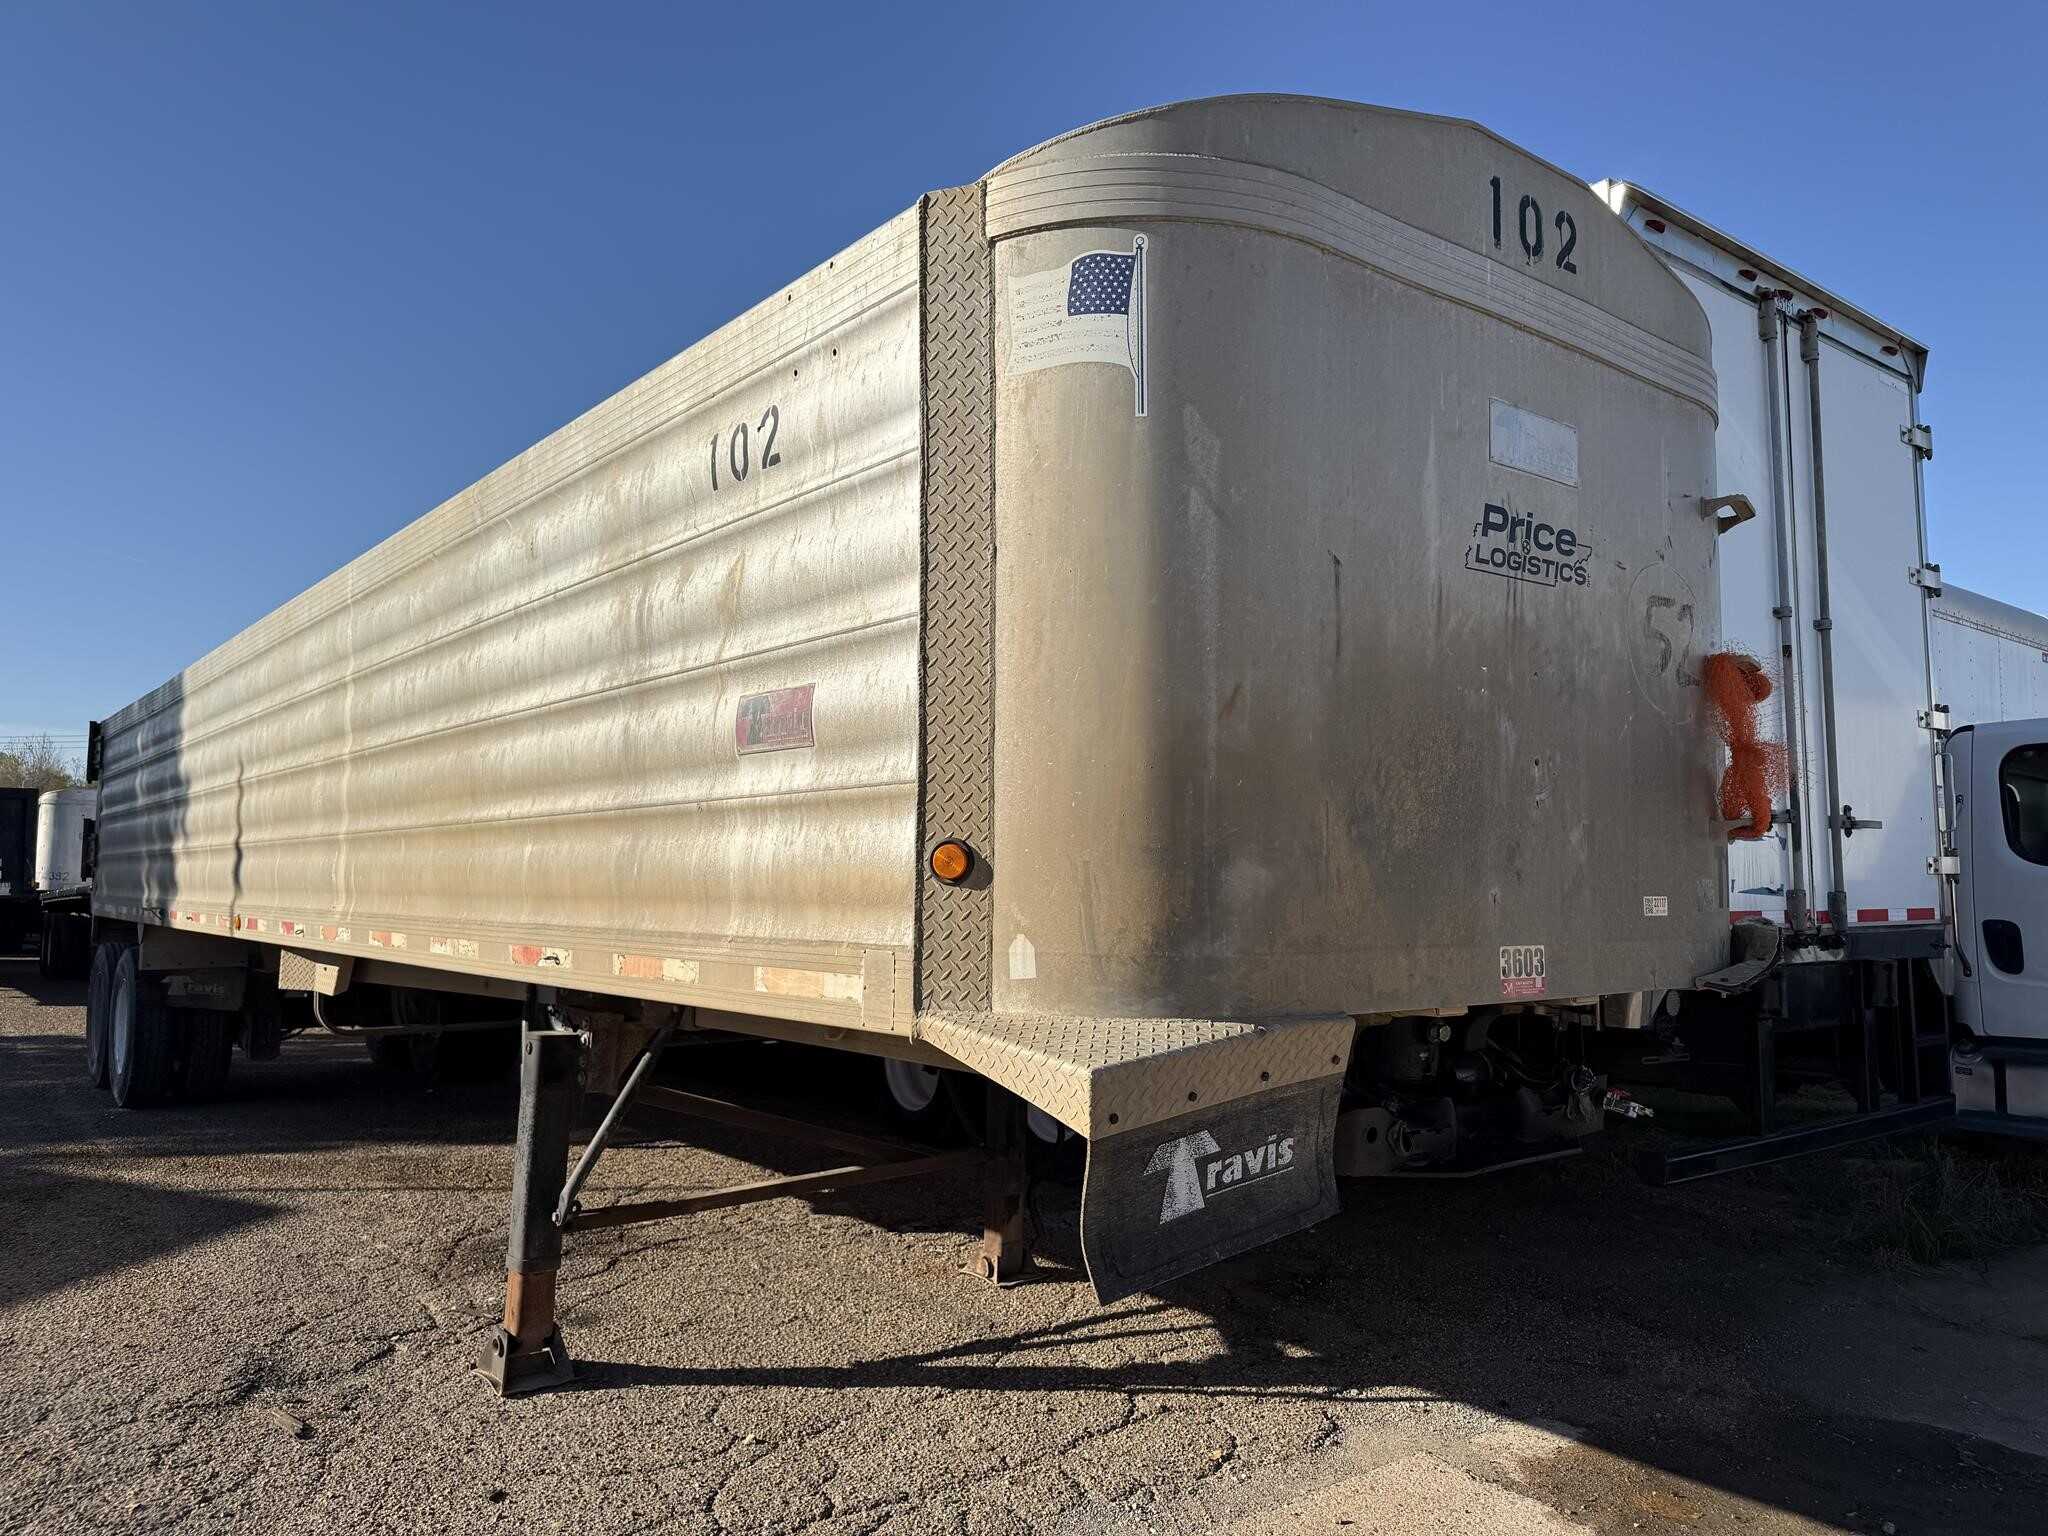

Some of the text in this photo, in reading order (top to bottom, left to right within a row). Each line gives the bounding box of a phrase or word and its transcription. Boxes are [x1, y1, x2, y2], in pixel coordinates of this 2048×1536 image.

[1490, 176, 1577, 274] 102
[710, 405, 781, 491] 102
[1475, 543, 1587, 586] LOGISTICS
[1481, 502, 1577, 557] Price
[1501, 946, 1545, 978] 3603
[1143, 1129, 1294, 1225] Travis
